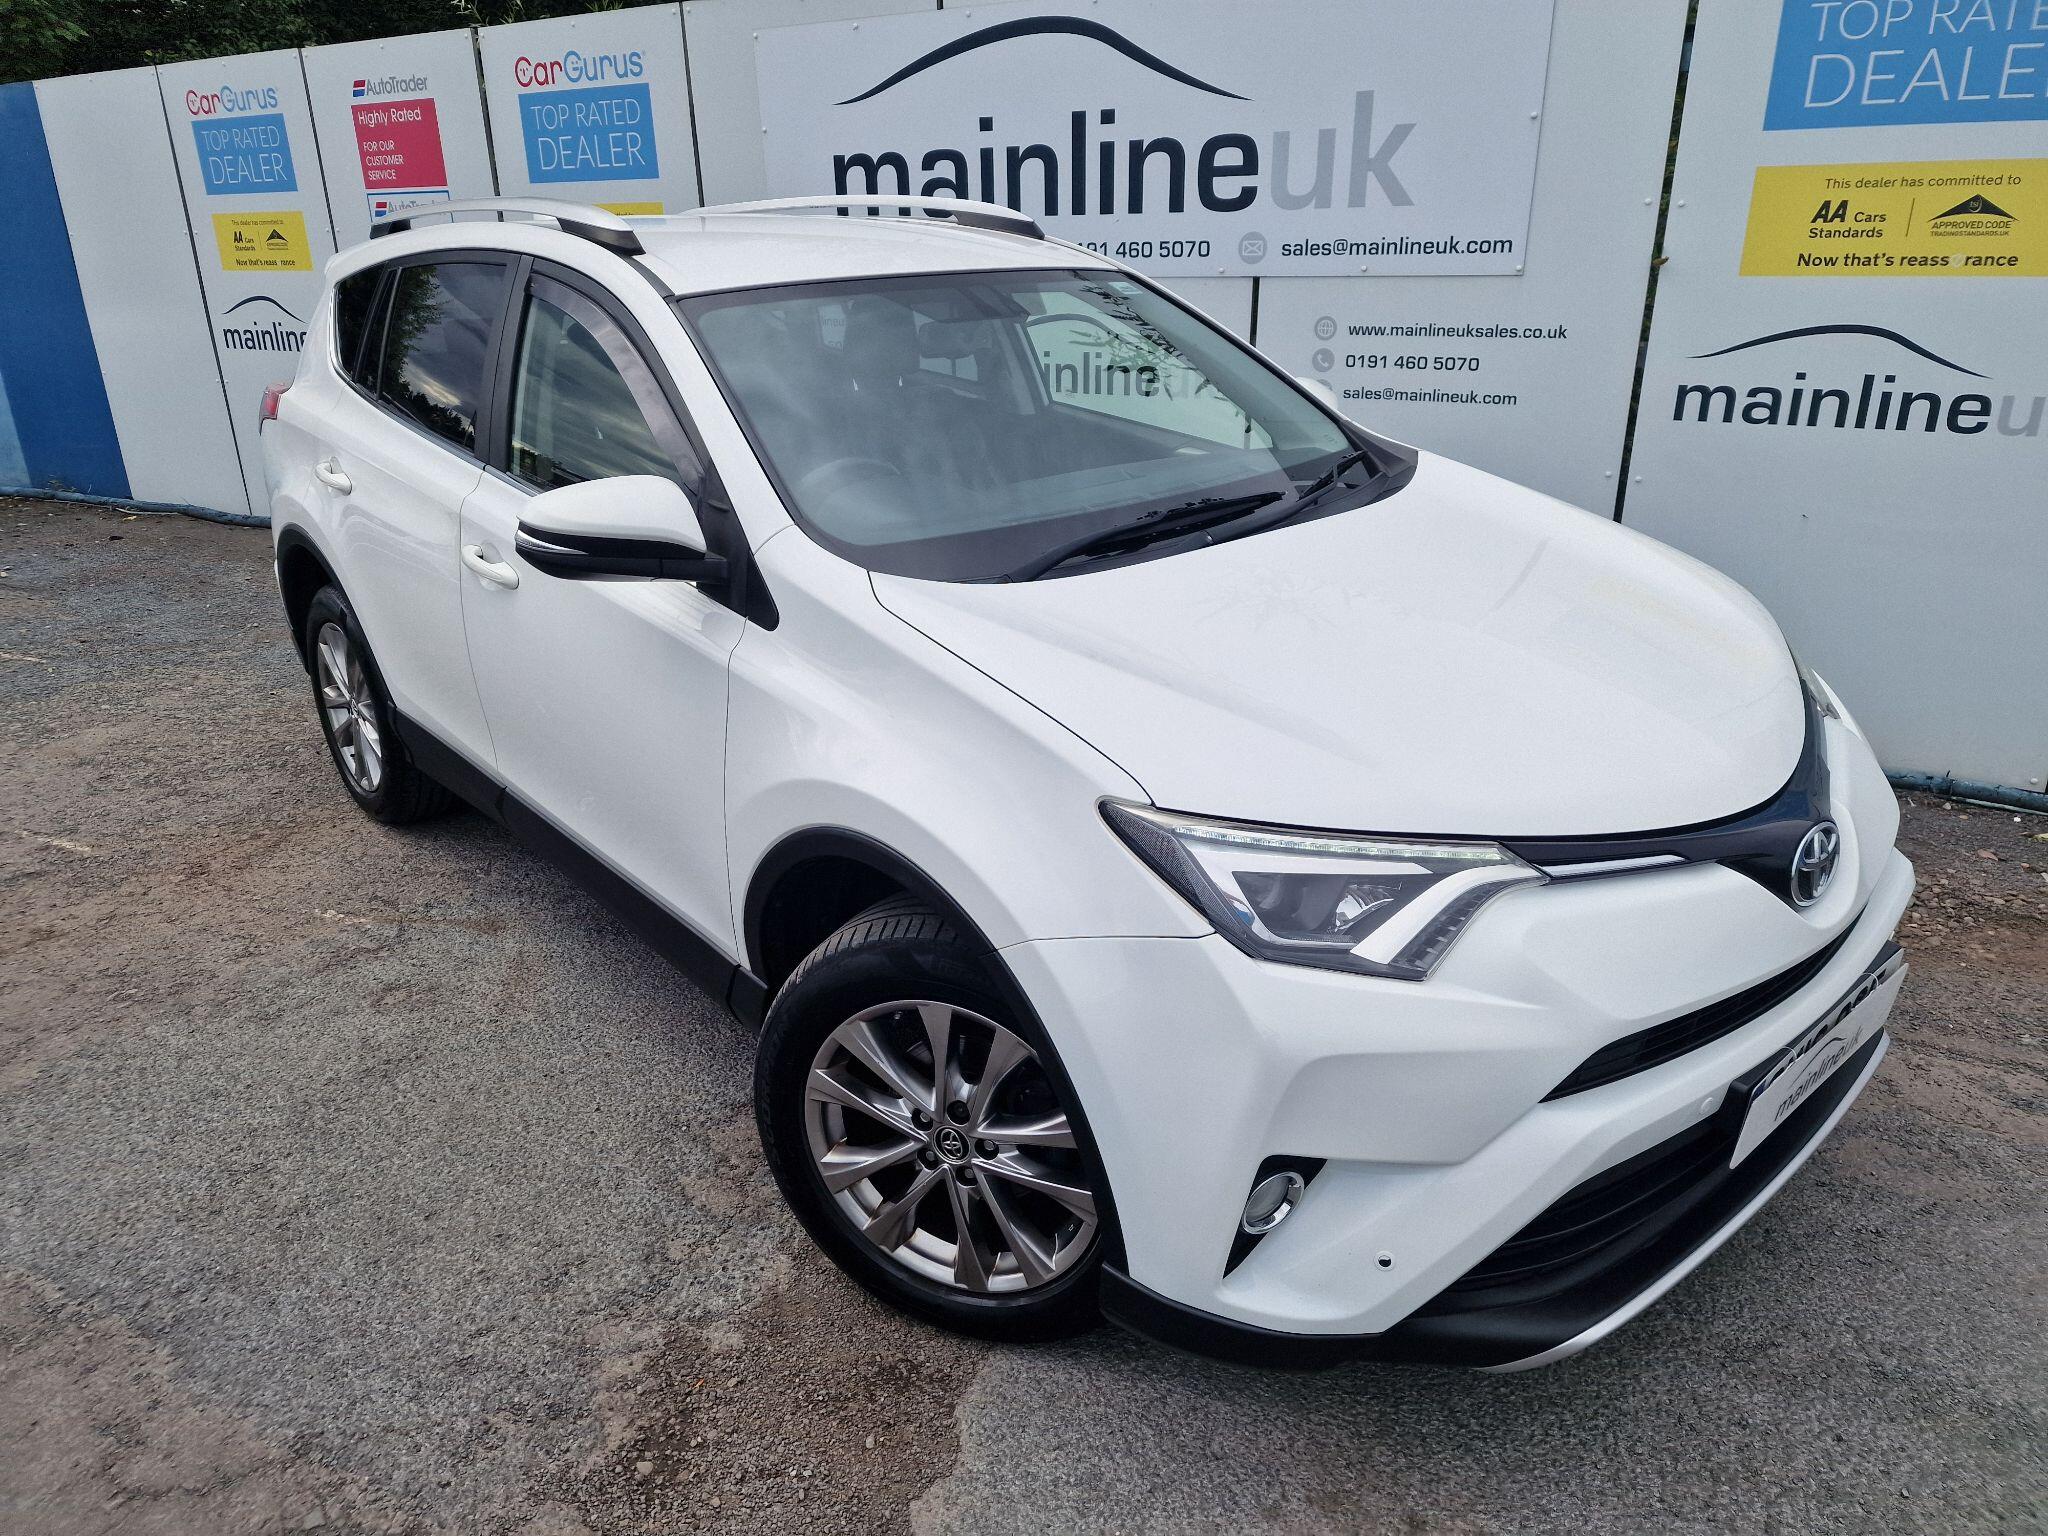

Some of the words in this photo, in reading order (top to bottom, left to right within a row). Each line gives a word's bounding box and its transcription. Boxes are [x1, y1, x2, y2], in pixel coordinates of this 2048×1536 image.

[1811, 0, 1913, 42] TOP
[514, 50, 644, 88] CarGurus
[1804, 42, 2048, 108] DEALE
[366, 74, 428, 96] AutoTrader
[185, 85, 278, 116] CarGurus
[358, 110, 388, 127] Highly
[391, 107, 421, 122] Rated
[530, 104, 569, 130] TOP
[575, 98, 641, 127] RATED
[201, 129, 229, 151] TOP
[232, 126, 280, 149] RATED
[363, 141, 378, 151] FOR
[379, 140, 395, 151] OUR
[366, 155, 404, 166] CUSTOMER
[538, 132, 646, 170] DEALER
[833, 90, 1417, 218] mainlineuk
[208, 153, 288, 184] DEALER
[368, 169, 397, 180] SERVICE
[1825, 177, 1851, 189] This
[1854, 176, 1898, 189] dealer
[1900, 176, 1924, 187] has
[1928, 174, 2003, 186] committed
[2007, 174, 2021, 186] to
[1810, 199, 1849, 224] AA
[1853, 211, 1887, 223] Cars
[1808, 226, 1883, 239] Standards
[1931, 220, 1984, 229] APPROVED
[1984, 220, 2012, 229] CODE
[233, 230, 244, 243] AA
[1281, 235, 1513, 258] sales@mainlineuk.com
[1115, 241, 1153, 258] 460
[1159, 240, 1210, 258] 5070
[1797, 252, 1838, 268] Now
[1842, 252, 1896, 268] that's
[1348, 323, 1568, 340] www.mainlineuksales.co.uk
[1345, 354, 1387, 369] 0191
[1393, 355, 1428, 370] 460
[1433, 356, 1480, 371] 5070
[1343, 387, 1517, 406] sales@mainlineuk.com
[1672, 372, 2048, 438] mainlineu
